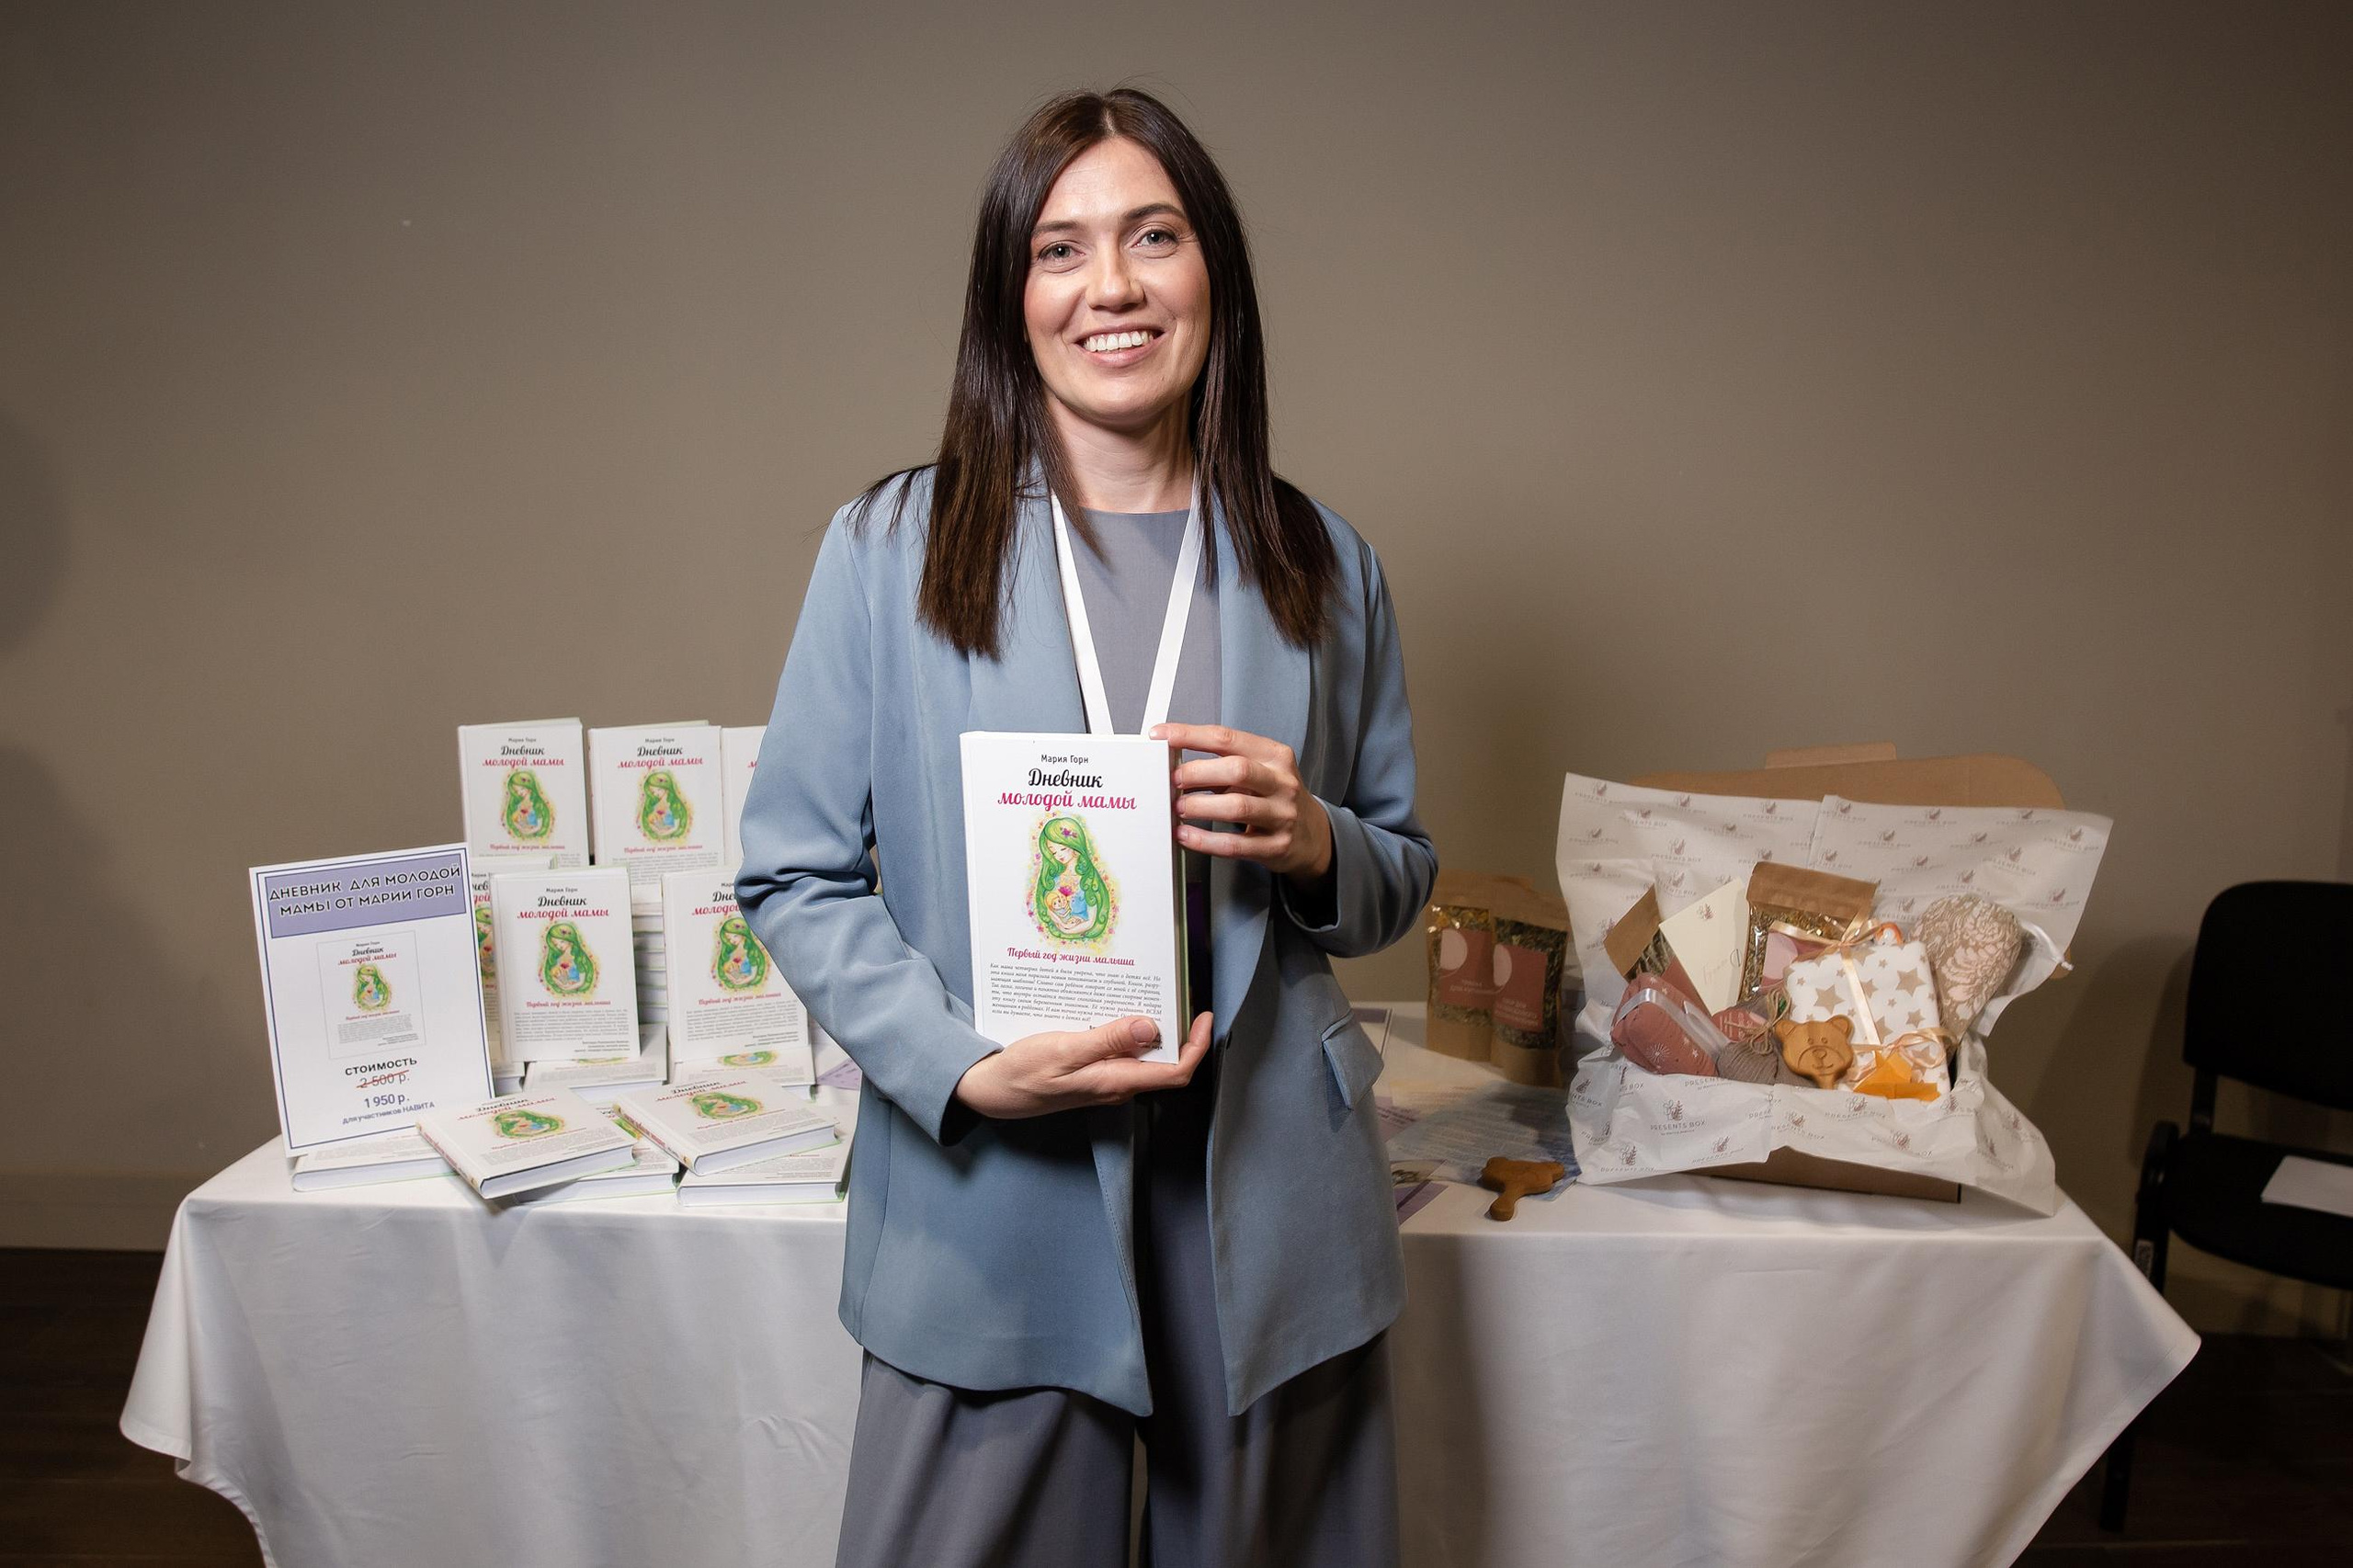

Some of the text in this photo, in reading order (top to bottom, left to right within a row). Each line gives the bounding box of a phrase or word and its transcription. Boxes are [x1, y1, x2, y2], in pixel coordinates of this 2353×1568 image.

[501, 745, 545, 756] Дневник
[637, 745, 683, 757] Дневник
[483, 758, 565, 769] молодой мамы
[617, 756, 704, 769] молодой мамы
[1040, 754, 1089, 765] Мария Горн
[1028, 767, 1104, 788] Дневник
[997, 790, 1138, 812] молодой мамы
[269, 881, 341, 901] ДНЕВНИК
[349, 876, 380, 892] ДЛЯ
[385, 864, 460, 886] МОЛОДОЙ
[279, 901, 331, 916] МАМЫ
[335, 896, 354, 910] ОТ
[358, 890, 413, 906] МАРИИ
[416, 884, 455, 899] ГОРН
[538, 895, 587, 908] Дневник
[517, 908, 609, 921] молодой мамы
[351, 947, 384, 957] Дневник
[1006, 947, 1135, 967] Первый год жизни малыша
[337, 953, 397, 966] молодой мамы
[345, 1057, 417, 1076] СТОИМОСТЬ
[359, 1077, 368, 1088] 2
[371, 1074, 395, 1087] 500
[364, 1098, 370, 1108] 1
[372, 1094, 395, 1108] 950
[342, 1101, 435, 1125] для участников НАВИТА
[1650, 1119, 1706, 1131] PRESENTS BOX
